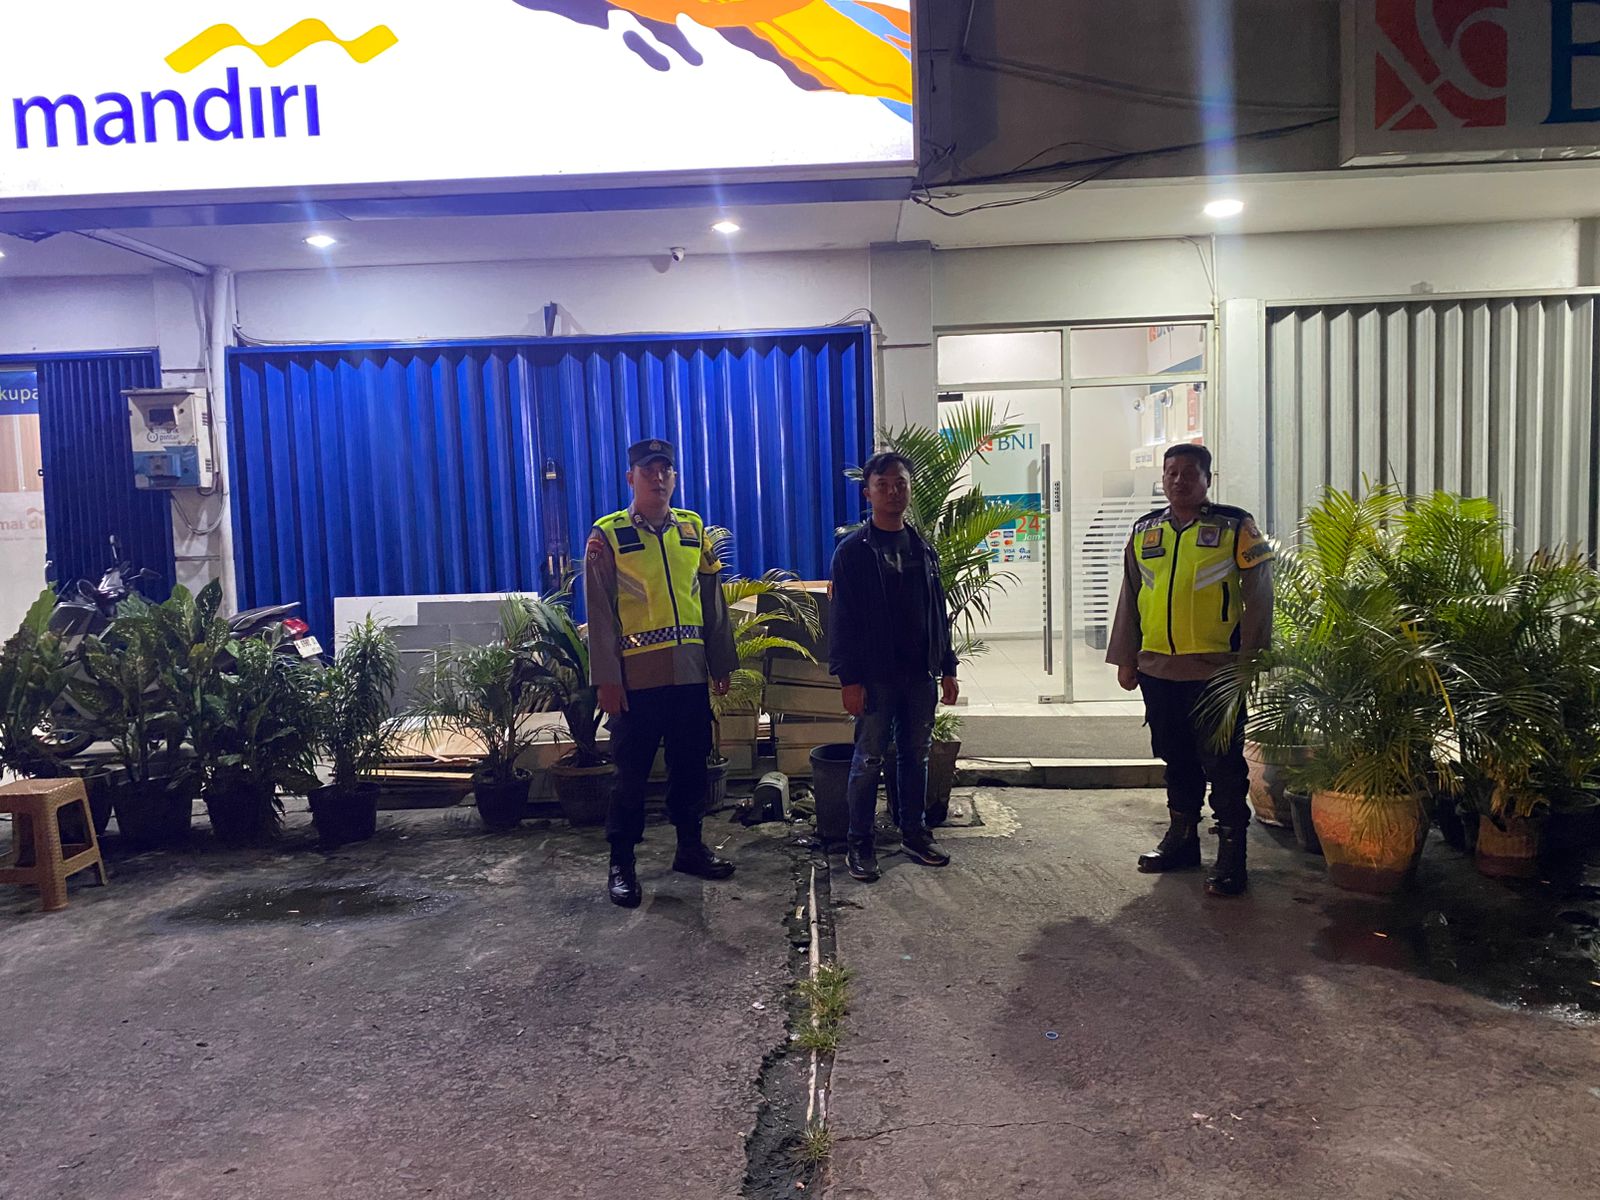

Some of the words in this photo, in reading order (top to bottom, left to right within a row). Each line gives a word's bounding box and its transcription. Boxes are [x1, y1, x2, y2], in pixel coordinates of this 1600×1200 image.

[13, 67, 320, 148] mandiri
[998, 432, 1033, 451] BNI
[1016, 513, 1040, 533] 24
[1024, 533, 1041, 541] Jam
